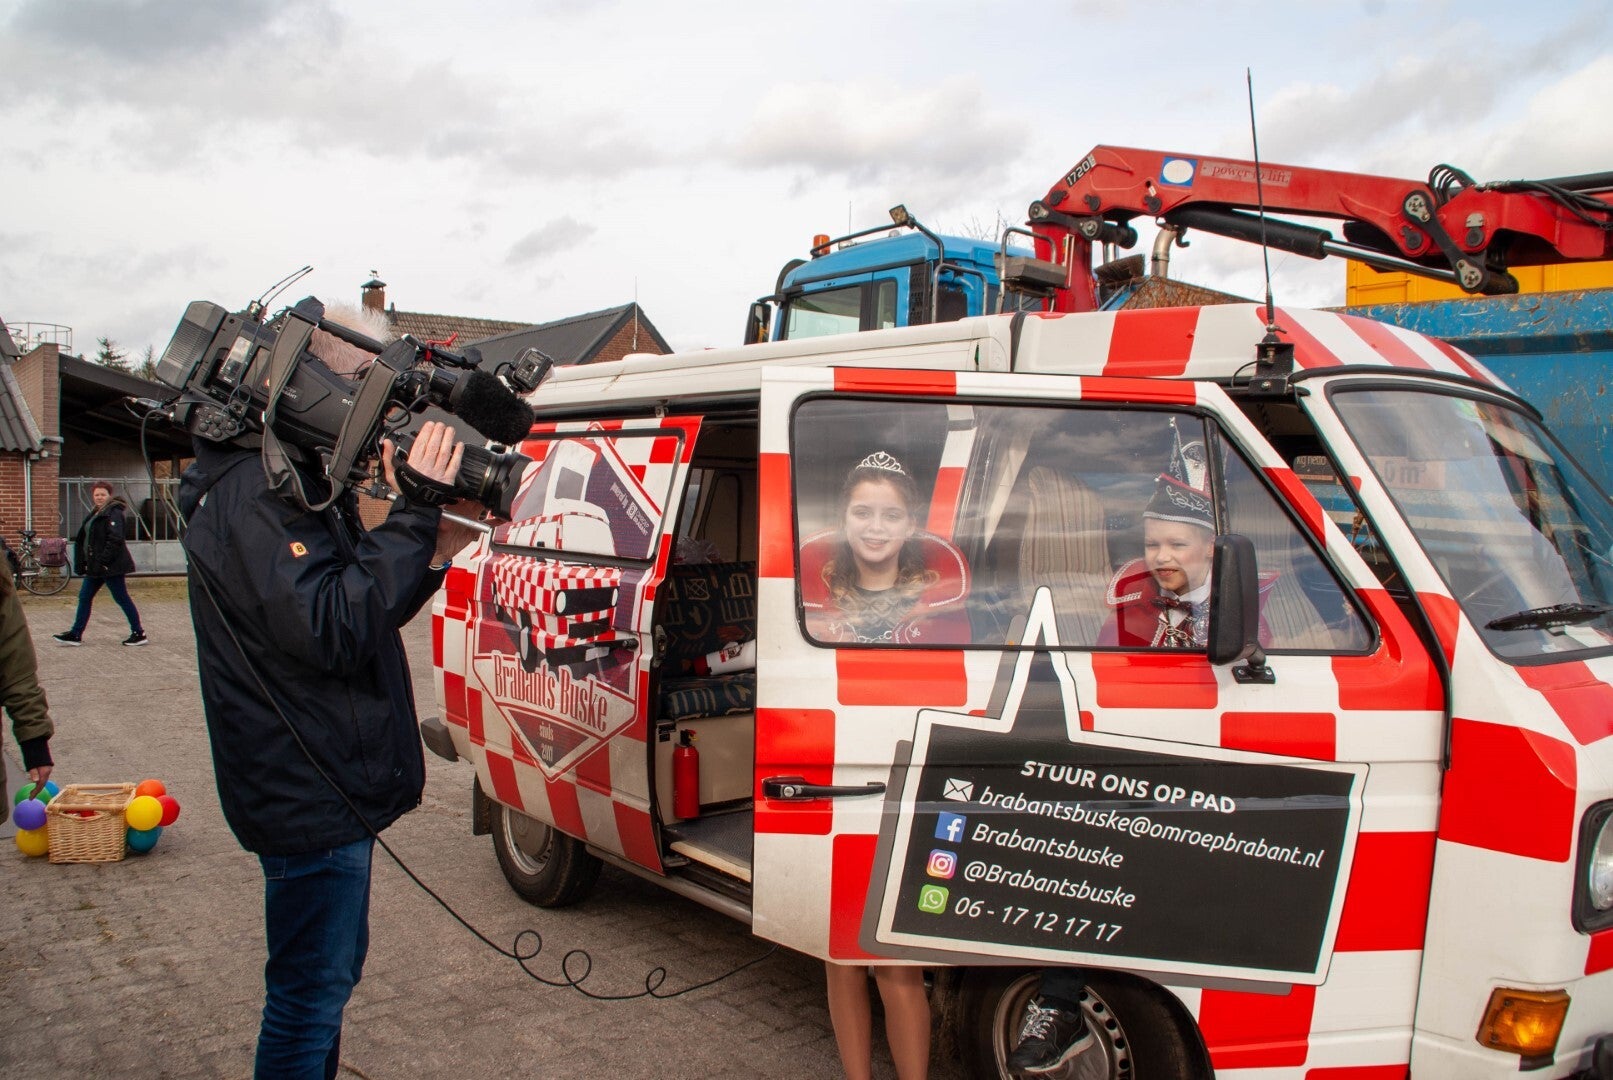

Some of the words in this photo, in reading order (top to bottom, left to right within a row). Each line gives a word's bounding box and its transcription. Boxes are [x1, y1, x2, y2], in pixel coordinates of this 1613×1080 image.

[1067, 160, 1091, 186] 1720
[1212, 166, 1250, 179] power
[493, 654, 556, 711] Brabants
[560, 668, 608, 733] Buske
[1020, 760, 1097, 789] STUUR
[1101, 774, 1150, 798] ONS
[1153, 784, 1186, 804] OP
[1190, 790, 1236, 814] PAD
[971, 823, 1124, 868] Brabantsbuske
[979, 786, 1325, 868] brabantsbuske@omroepbrabant.nl
[964, 860, 1136, 908] @Brabantsbuske
[954, 897, 985, 918] 06
[1002, 906, 1030, 926] 17
[1033, 911, 1059, 932] 12
[1065, 917, 1092, 937] 17
[1095, 923, 1123, 942] 17
